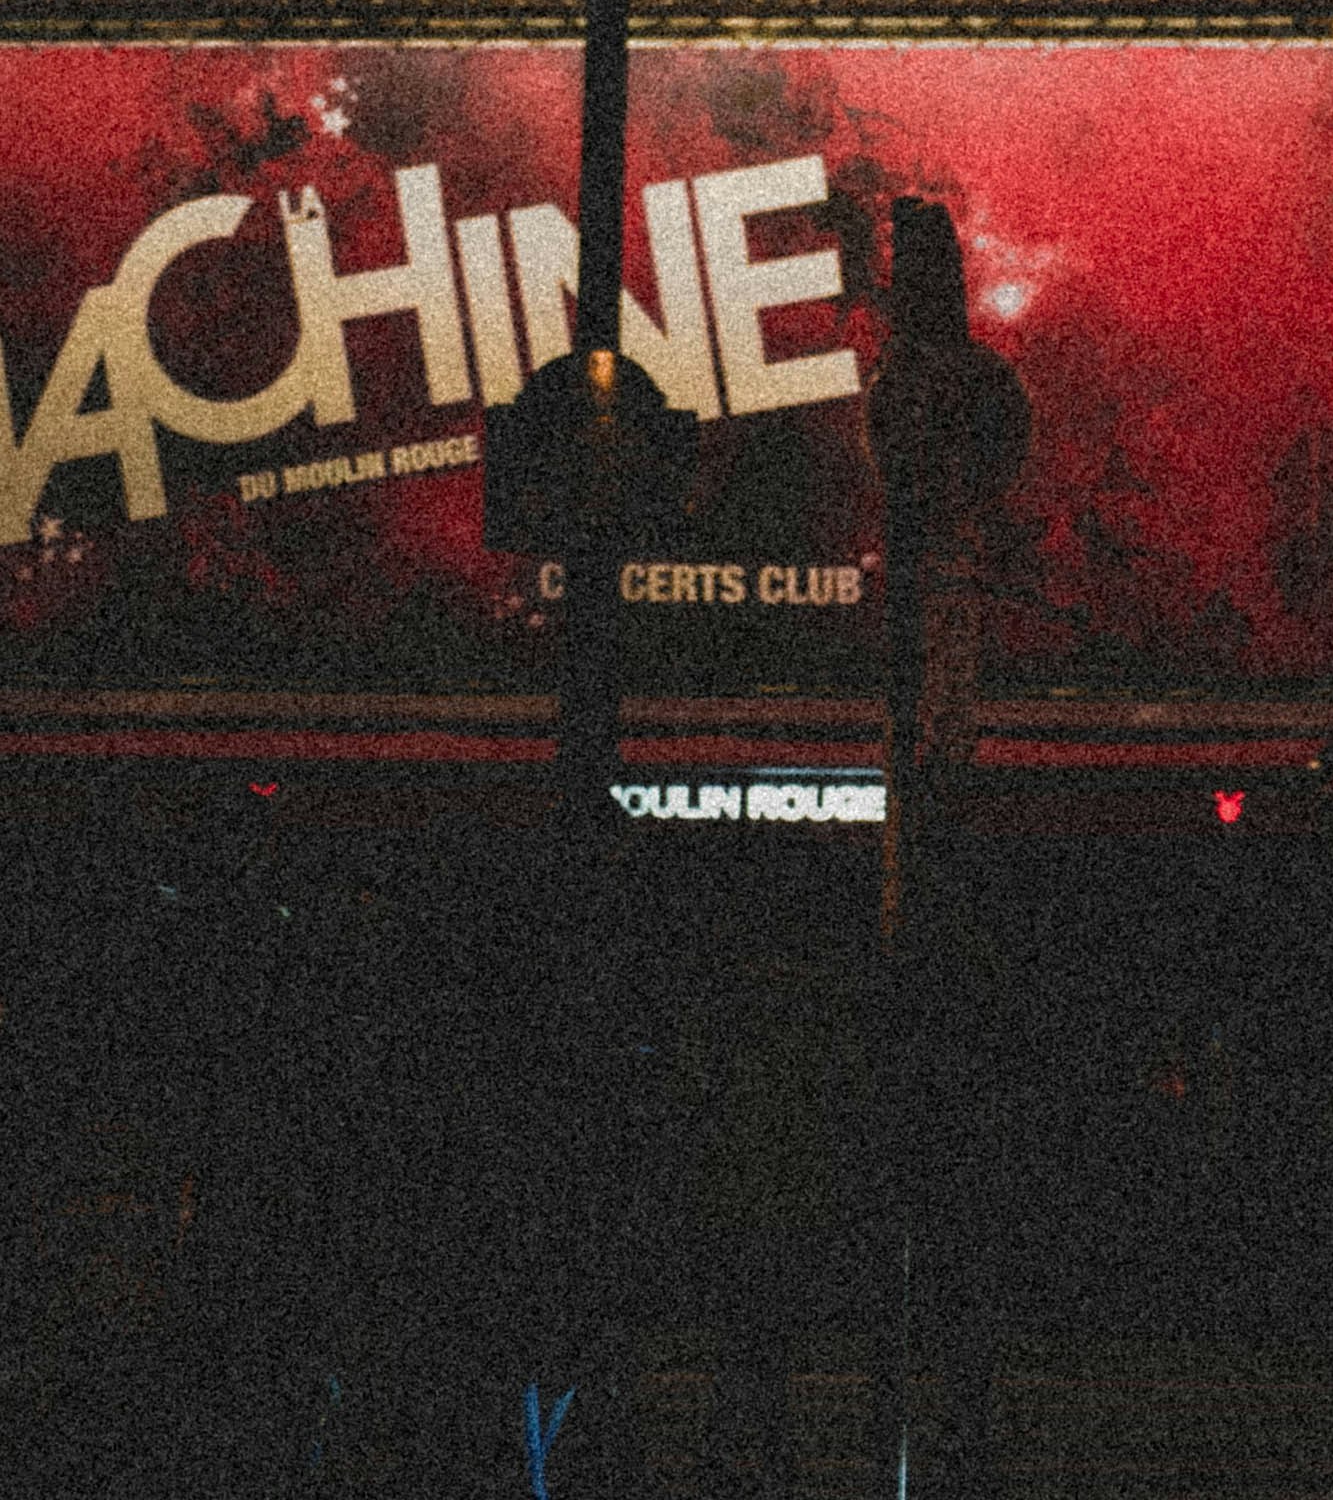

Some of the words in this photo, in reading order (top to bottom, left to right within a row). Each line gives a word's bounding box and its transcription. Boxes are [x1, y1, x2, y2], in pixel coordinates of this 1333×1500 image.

[236, 471, 278, 502] DU
[282, 451, 387, 495] MOULIN
[390, 434, 481, 476] ROUGE
[538, 560, 748, 604] CCERTS
[757, 562, 863, 606] CLUB
[609, 783, 741, 819] OULIN
[746, 782, 887, 822] ROUGE
